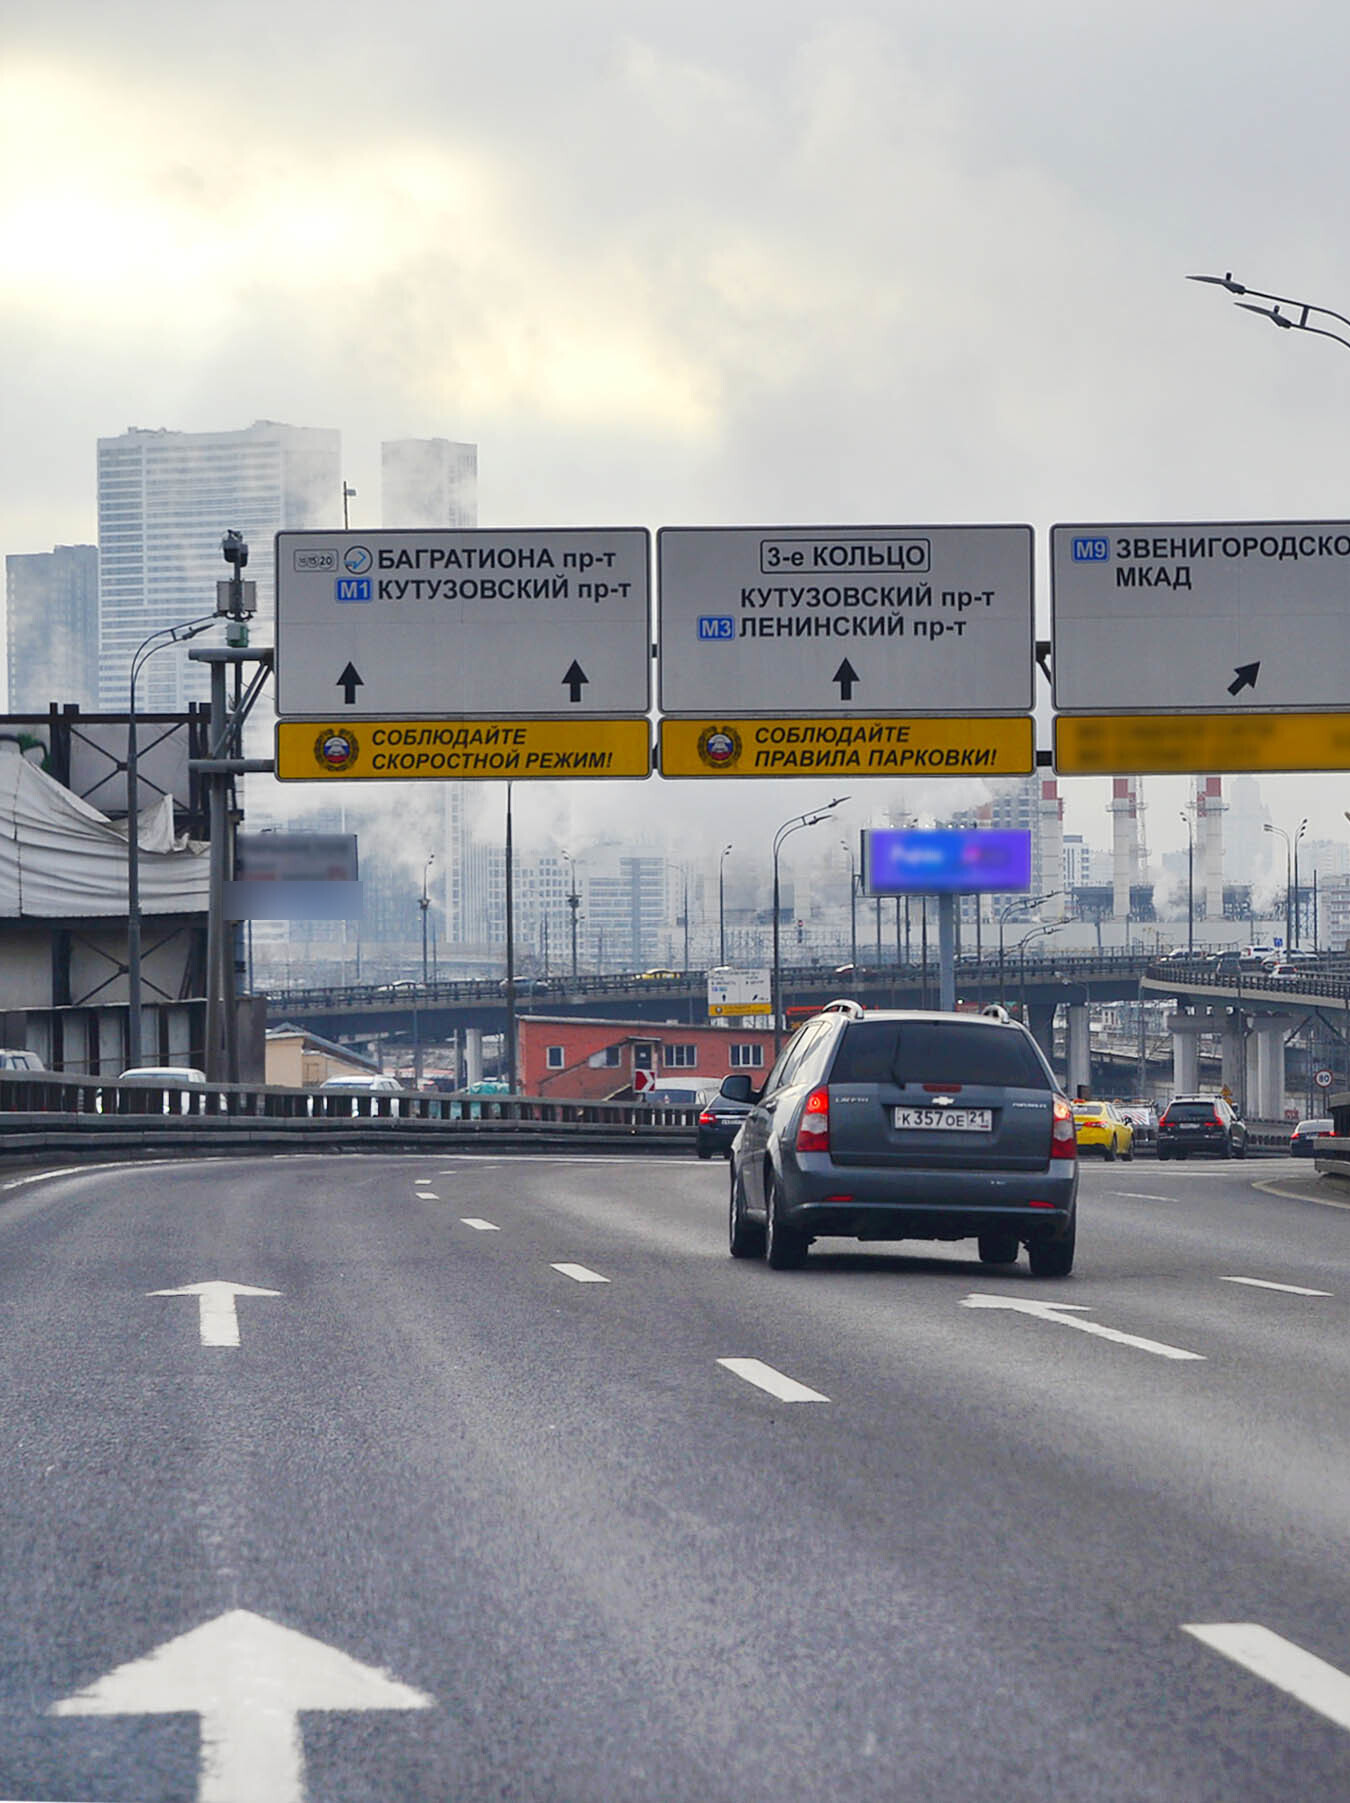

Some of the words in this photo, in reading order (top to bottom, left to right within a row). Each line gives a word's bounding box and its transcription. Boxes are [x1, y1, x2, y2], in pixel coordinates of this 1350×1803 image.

[378, 549, 555, 569] БАГРАТИОНА
[563, 552, 617, 572] пр-т
[767, 547, 805, 567] 3-е
[814, 545, 926, 569] КОЛЬЦО
[1076, 541, 1107, 559] М9
[340, 581, 368, 598] М1
[378, 575, 568, 600] КУТУЗОВСКИЙ
[579, 582, 632, 602] пр-т
[1116, 566, 1192, 589] МКАД
[740, 582, 932, 608] КУТУЗОВСКИЙ
[941, 589, 995, 610] пр-т
[702, 618, 732, 637] М3
[740, 611, 904, 638] ЛЕНИНСКИЙ
[913, 618, 967, 641] пр-т
[372, 726, 527, 746] СОБЛЮДАЙТЕ
[755, 724, 911, 745] СОБЛЮДАЙТЕ
[372, 750, 521, 769] СКОРОСТНОЙ
[525, 751, 613, 769] РЕЖИМ!
[755, 749, 861, 768] ПРАВИЛА
[868, 748, 998, 767] ПАРКОВКИ!
[969, 1111, 986, 1124] 21
